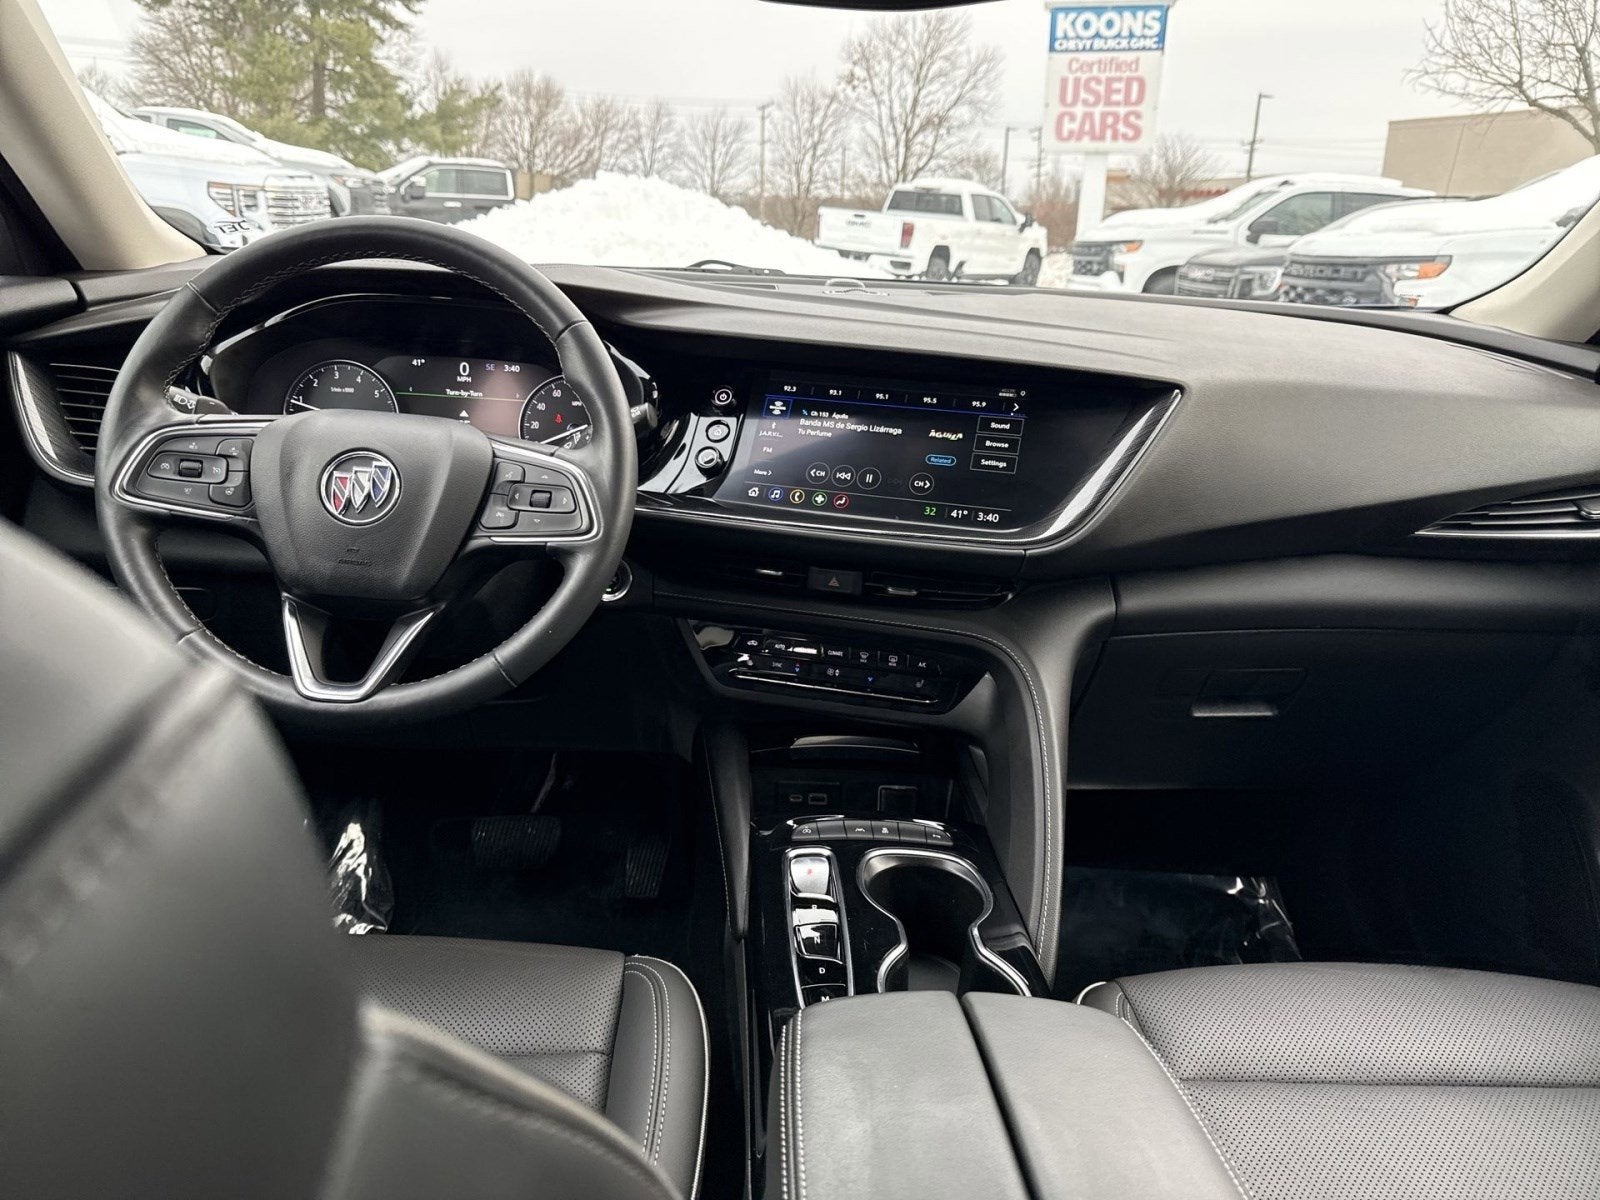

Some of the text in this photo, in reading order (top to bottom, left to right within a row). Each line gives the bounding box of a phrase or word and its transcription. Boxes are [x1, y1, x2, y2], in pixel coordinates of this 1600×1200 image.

[1056, 10, 1162, 39] KOONS
[1068, 56, 1140, 74] Certified
[1058, 76, 1146, 108] USED
[1055, 110, 1142, 142] CARS
[460, 362, 470, 376] 0
[486, 363, 496, 371] SE
[504, 364, 520, 372] 3:40
[334, 371, 339, 379] 3
[374, 390, 379, 398] 5
[552, 389, 561, 398] 60
[536, 402, 546, 410] 40
[530, 421, 539, 429] 20
[800, 418, 821, 427] Banda
[846, 423, 868, 432] Sergio
[870, 425, 902, 435] Lizárraga
[990, 422, 1010, 430] Sound
[985, 440, 1009, 448] Browse
[981, 459, 1007, 468] Settings
[924, 507, 936, 516] 32
[951, 510, 968, 518] 41°
[977, 512, 1000, 522] 3:40
